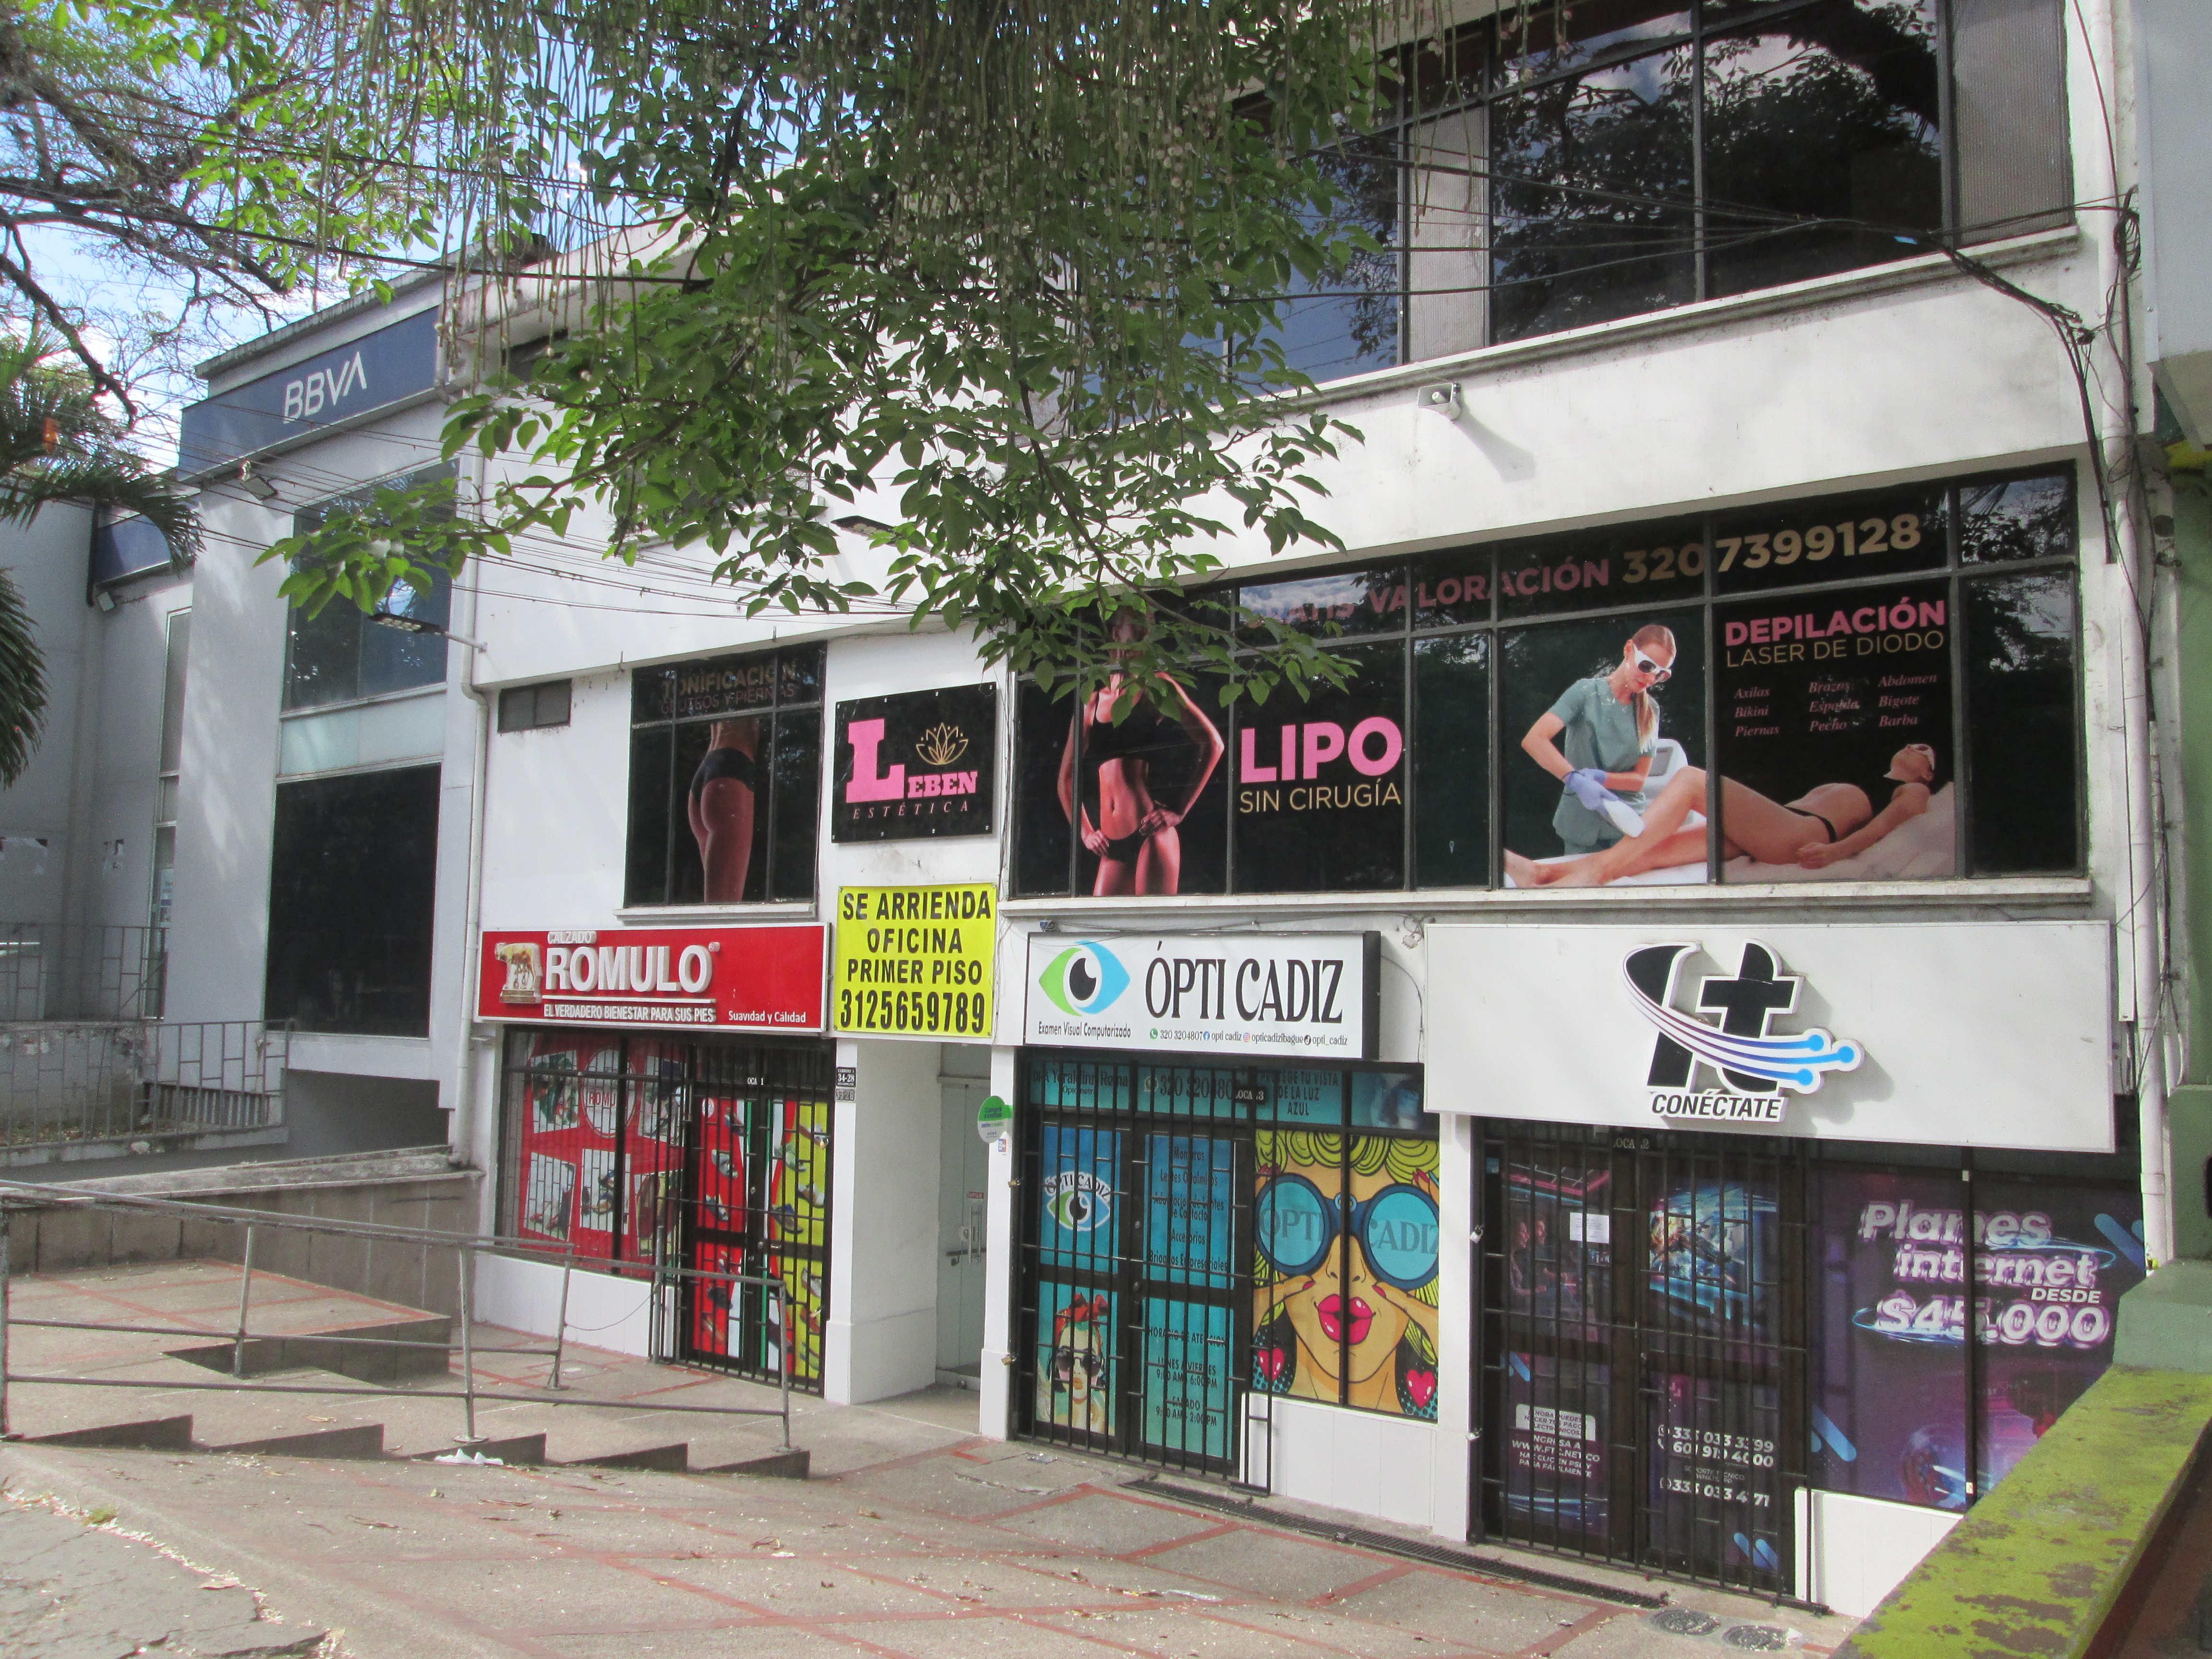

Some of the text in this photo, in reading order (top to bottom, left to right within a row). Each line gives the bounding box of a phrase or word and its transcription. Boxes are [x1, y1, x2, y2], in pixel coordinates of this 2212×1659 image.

[284, 351, 367, 424] BBVA
[1246, 513, 1921, 628] RATIS VALORACIÓN 320 7399128
[1726, 597, 1946, 646] DEPILACIÓN
[1727, 630, 1944, 668] LASER DE DIODO
[1809, 682, 1850, 693] Brazos
[1878, 674, 1938, 687] Abdomen
[1734, 686, 1770, 698] Axilas
[1878, 695, 1920, 709] Bigote
[1735, 706, 1769, 718] Bikini
[1809, 719, 1848, 732] Pecho
[1879, 714, 1919, 727] Barba
[1735, 725, 1780, 737] Piernas
[1240, 716, 1403, 784] LIPO
[846, 718, 978, 804] LEBEN
[1239, 778, 1402, 814] SIN CIRUGÍA
[852, 800, 969, 820] ESTÉTICA
[842, 890, 991, 920] SE ARRIENDA
[547, 931, 594, 944] CALZADO
[867, 928, 963, 954] OFICINA
[545, 945, 713, 993] ROMULO
[847, 959, 983, 986] PRIMER PISO
[1145, 941, 1345, 1024] ÓPTI CADIZ
[544, 1004, 716, 1022] EL VERDADERO BIENESTAR PARA SUS PIES
[728, 1010, 765, 1022] Suavidad
[767, 1013, 773, 1024] y
[841, 989, 985, 1034] 3125659789
[1038, 1021, 1131, 1041] Examen Visual Computarizado
[1160, 1030, 1172, 1039] 320
[1174, 1031, 1203, 1041] 3204807
[1211, 1032, 1224, 1042] opti
[1225, 1032, 1242, 1041] cadiz
[1312, 1034, 1348, 1046] opti_cadiz
[838, 1073, 855, 1082] 34-28
[1101, 1071, 1129, 1087] Rena
[1261, 1070, 1298, 1084] PREGE
[1187, 1076, 1235, 1100] 32080
[1278, 1086, 1320, 1101] DE LA LUZ
[584, 1091, 618, 1107] ROMU
[1651, 1090, 1782, 1119] CONÉCTATE
[1287, 1102, 1309, 1116] AZUL
[1173, 1146, 1205, 1162] Monras
[1046, 1174, 1073, 1194] ÓTI
[1161, 1169, 1181, 1183] Lees
[1179, 1206, 1208, 1221] Cotacto
[1859, 1201, 2052, 1249] Planes
[1171, 1228, 1205, 1245] Acceorios
[1150, 1250, 1227, 1272] Brigaas Epresaiales
[1893, 1243, 2099, 1289] internet
[2031, 1287, 2102, 1304] DESDE
[1875, 1291, 2110, 1347] $45.000
[1156, 1369, 1170, 1381] 9:0
[1188, 1361, 1216, 1375] VIERES
[1172, 1396, 1200, 1410] SAADO
[1156, 1406, 1170, 1417] 9:0
[1559, 1414, 1582, 1422] UEDES
[1533, 1435, 1581, 1450] NGRSA A
[1537, 1455, 1555, 1463] CLIC
[1684, 1465, 1744, 1480] SOORTE TCNICO
[1736, 1491, 1770, 1507] 471
